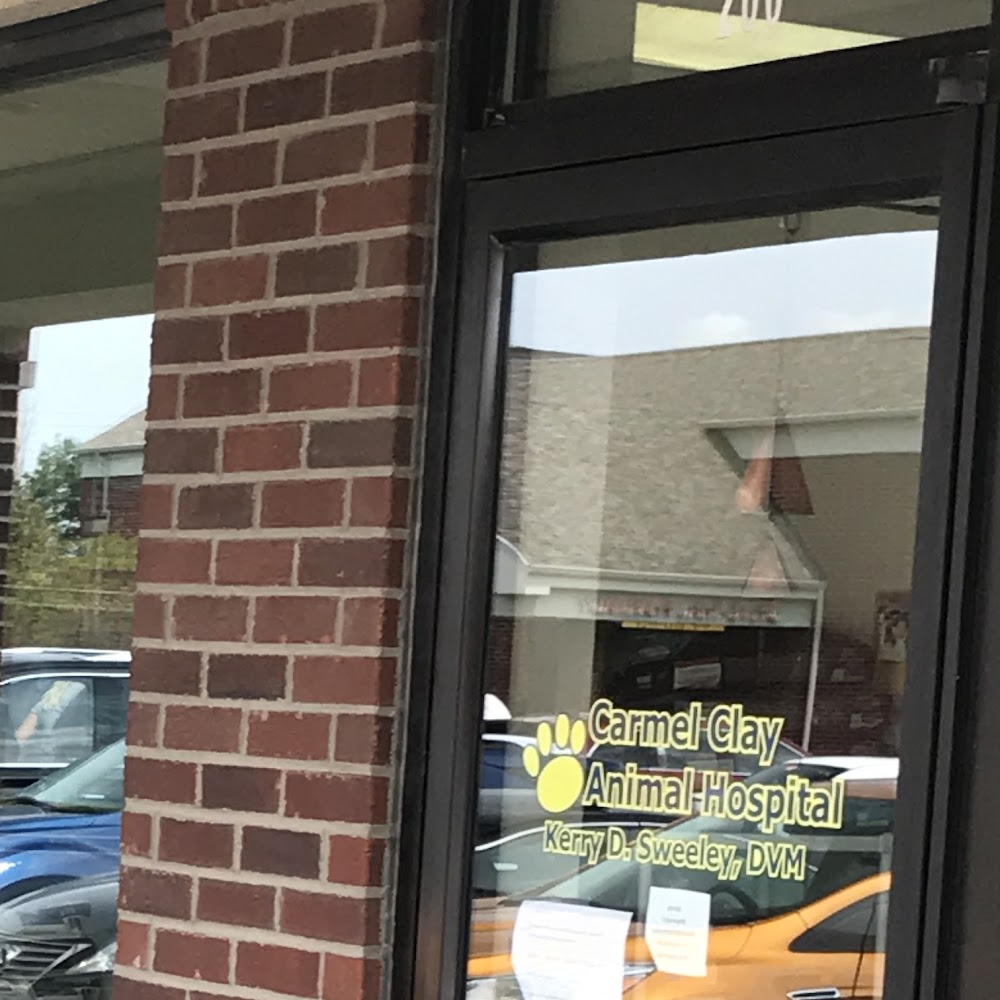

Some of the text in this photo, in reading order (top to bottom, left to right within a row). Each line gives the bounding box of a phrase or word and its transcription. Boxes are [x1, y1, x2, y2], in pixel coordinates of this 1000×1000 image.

[586, 698, 785, 766] Carmel Clay
[582, 761, 845, 834] Animal Hospital
[543, 820, 809, 881] Kerry D. Sweeley, DVM
